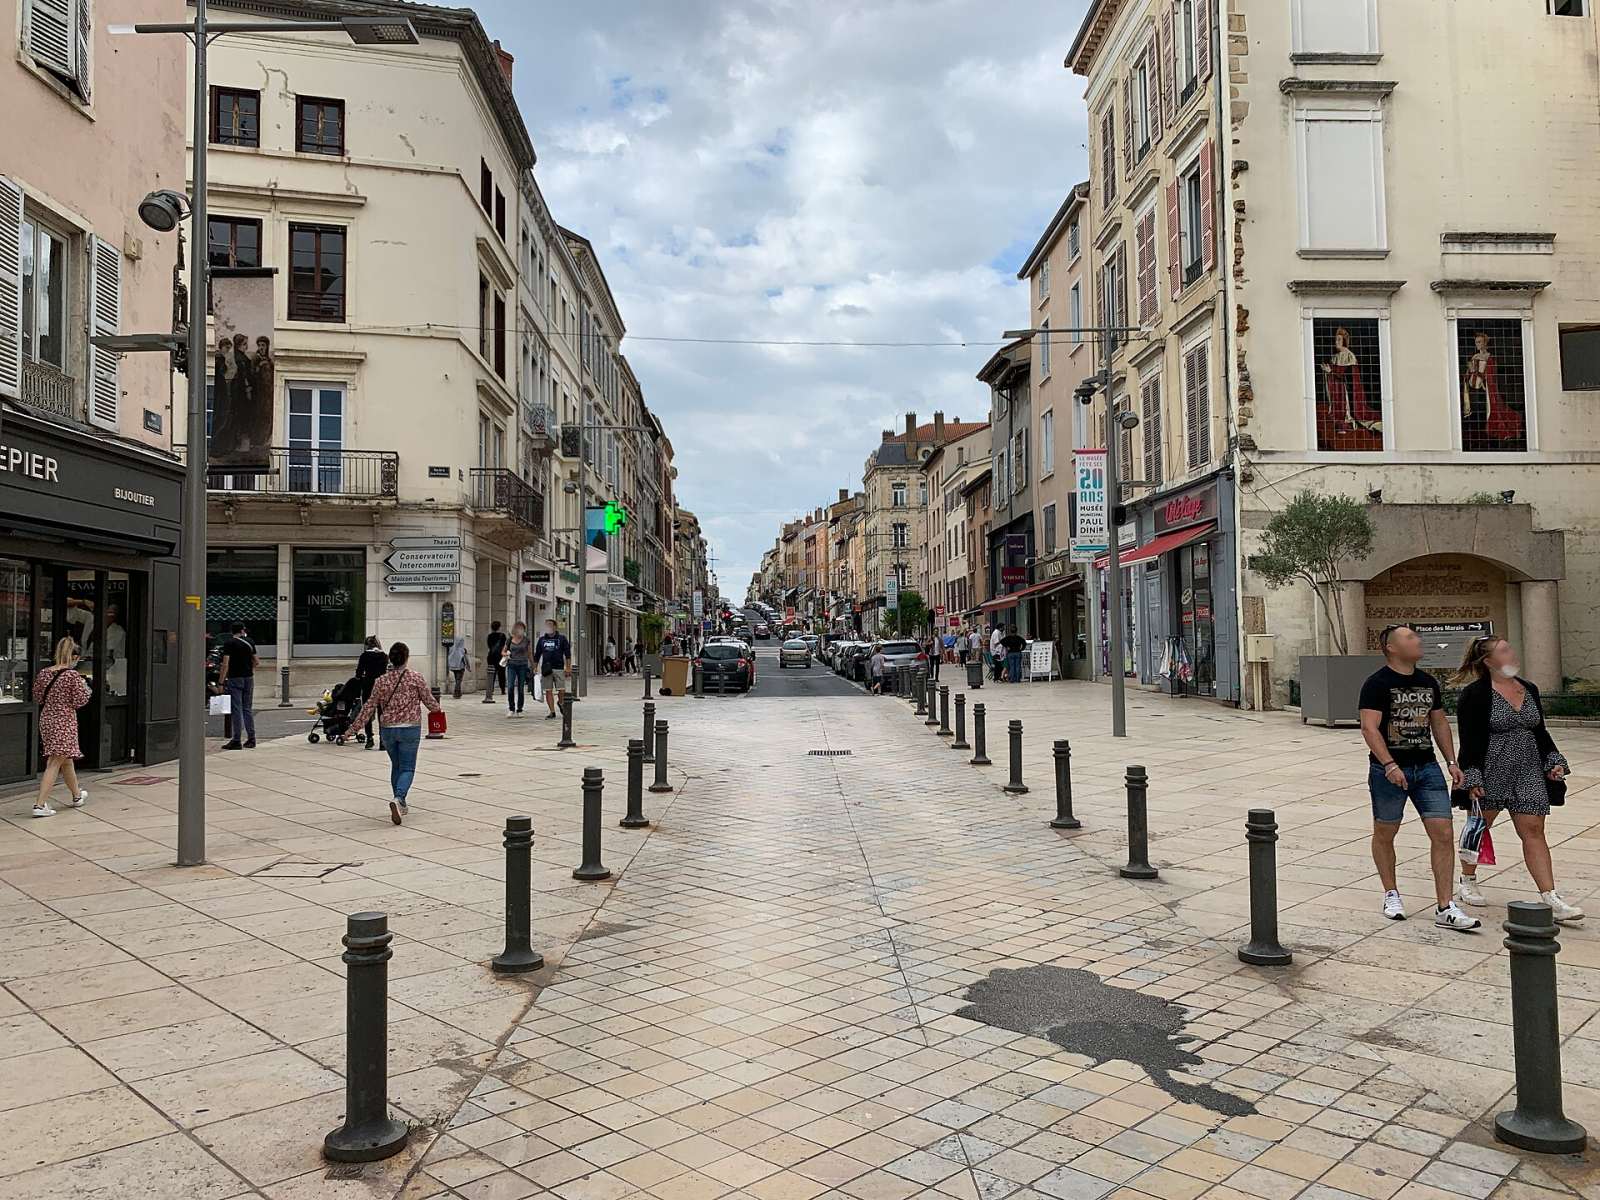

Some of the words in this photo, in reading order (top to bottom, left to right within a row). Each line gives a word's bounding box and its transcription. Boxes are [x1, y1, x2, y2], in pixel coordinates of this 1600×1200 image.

[1080, 468, 1103, 489] 20
[114, 487, 155, 507] BIJOUTIER
[1080, 518, 1104, 526] PAUL
[400, 552, 454, 560] Conservatoire
[400, 561, 458, 569] Intercommunal
[307, 594, 344, 606] INIRIS
